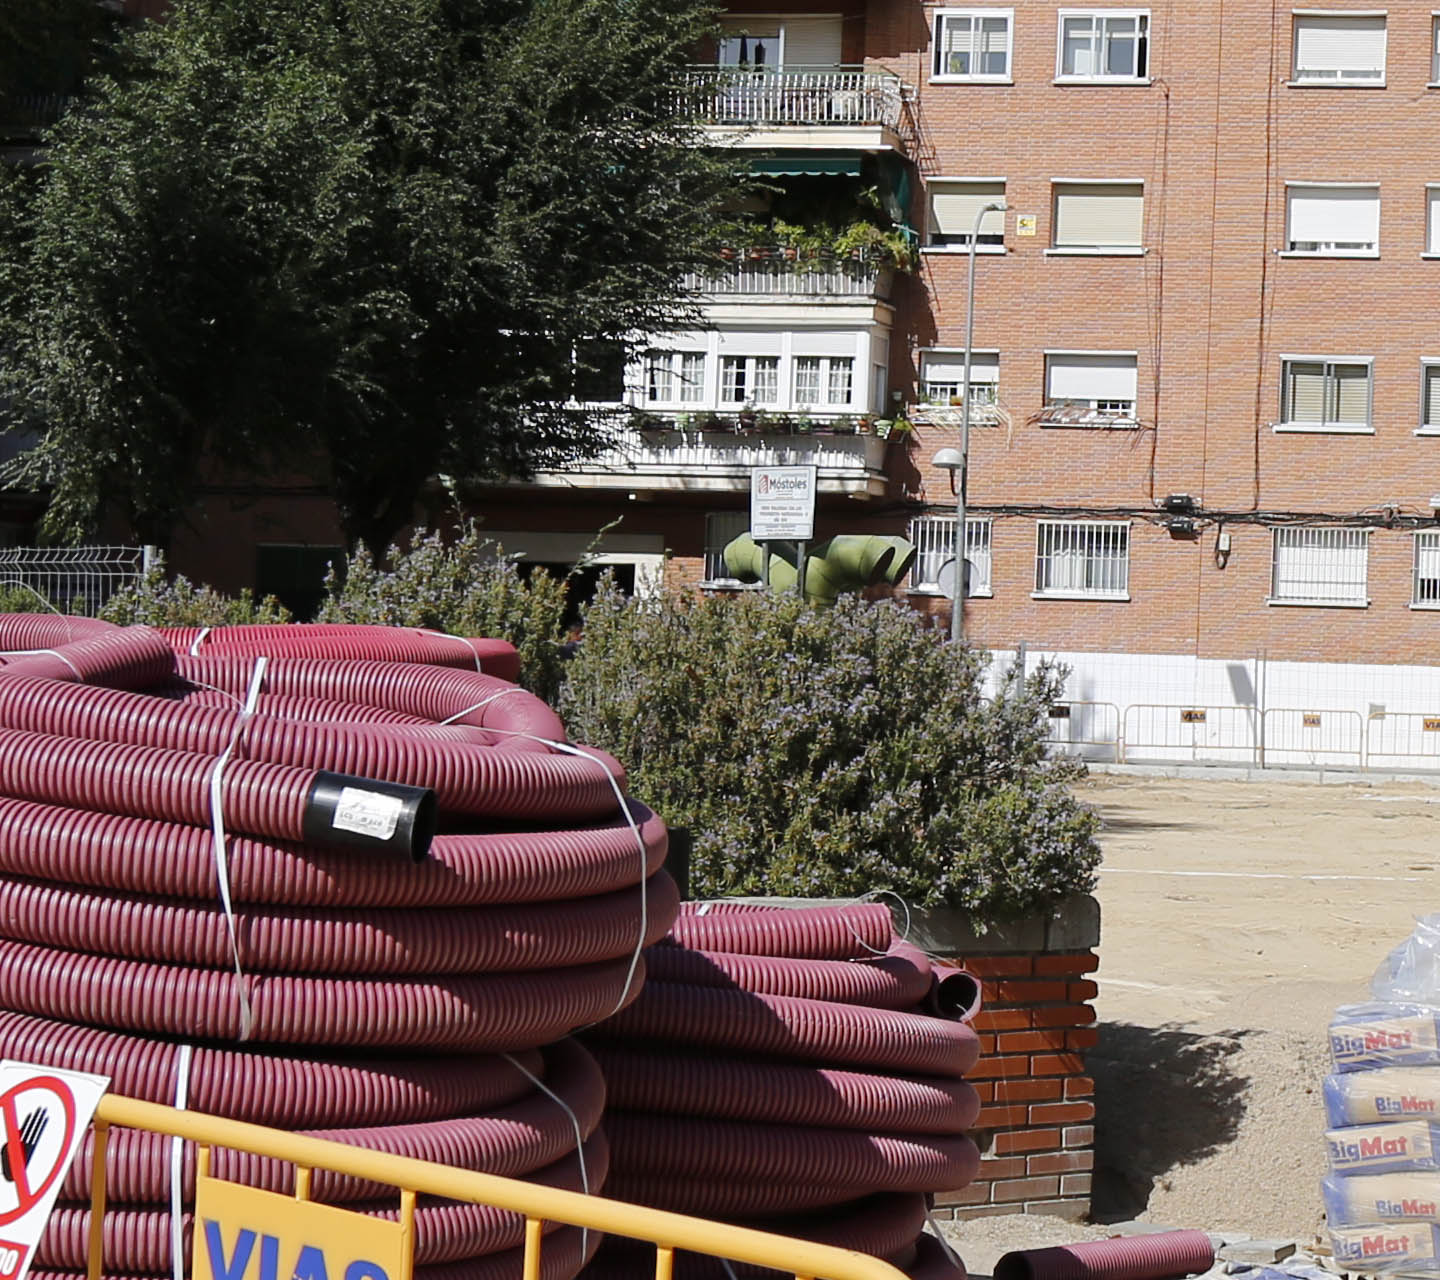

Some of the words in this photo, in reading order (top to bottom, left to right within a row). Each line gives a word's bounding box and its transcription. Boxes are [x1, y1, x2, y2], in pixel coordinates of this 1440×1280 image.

[1331, 1030, 1413, 1054] BigMat
[1375, 1096, 1436, 1114] BigMat
[1330, 1136, 1407, 1161] BigMat
[1376, 1199, 1437, 1216] BigMat
[1332, 1234, 1410, 1260] BigMat
